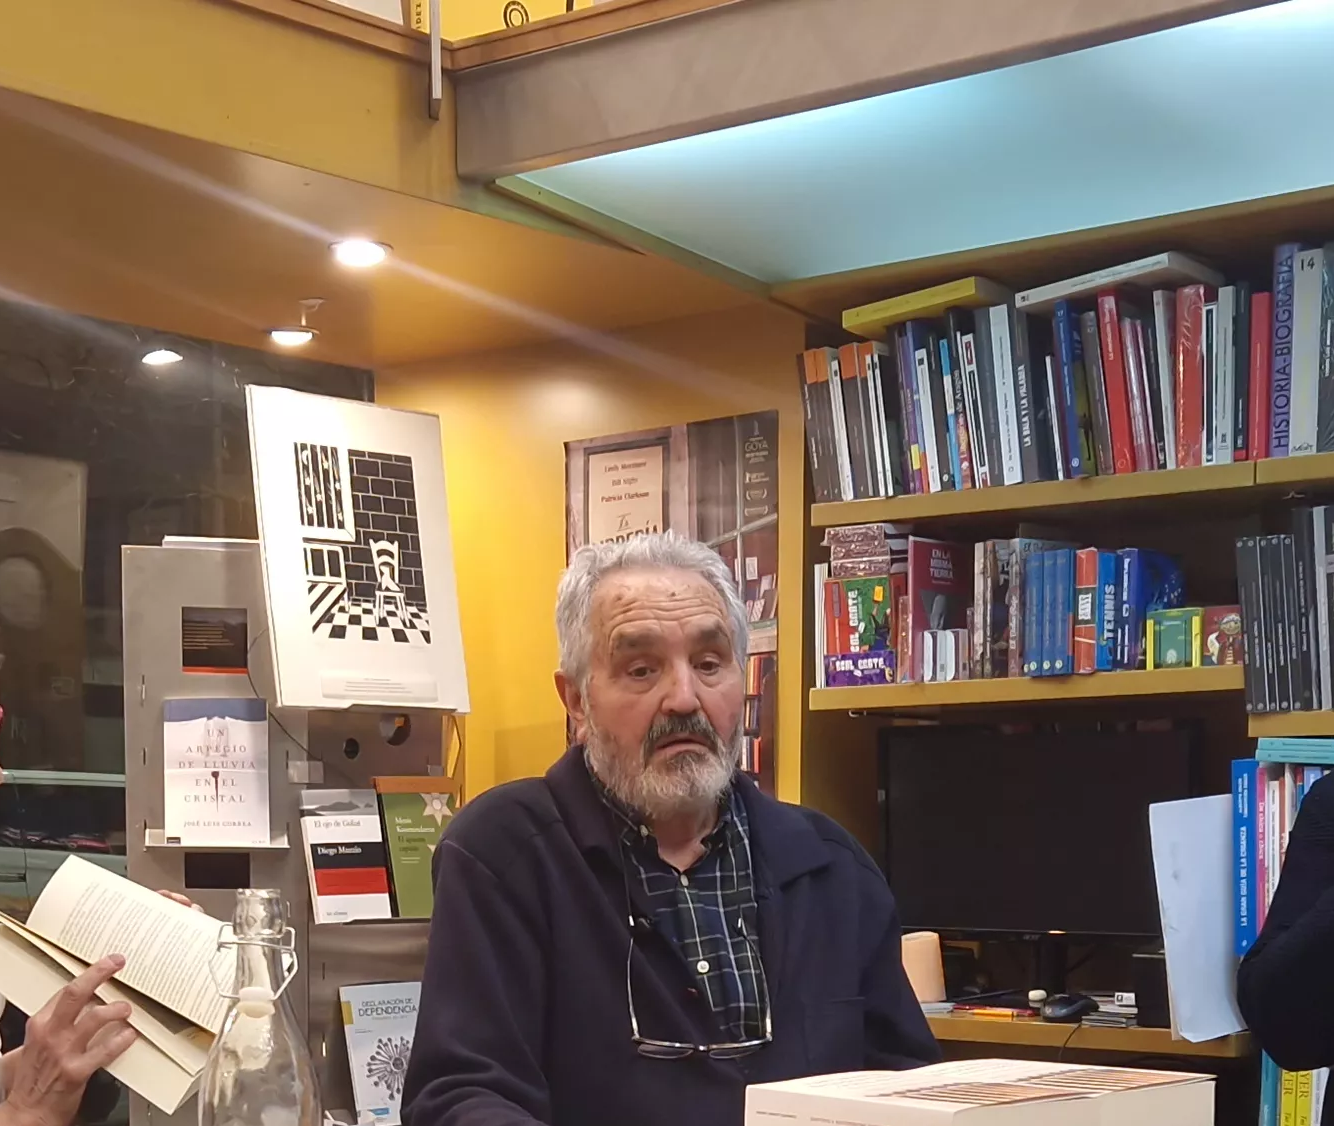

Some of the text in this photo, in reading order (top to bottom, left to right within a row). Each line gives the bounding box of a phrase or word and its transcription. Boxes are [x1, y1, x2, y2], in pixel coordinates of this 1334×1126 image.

[1299, 256, 1316, 271] 14
[1104, 584, 1115, 640] TENNIS
[207, 729, 225, 737] UN
[185, 745, 247, 754] ARPEGIO
[179, 761, 256, 770] DE LLUVIA
[196, 779, 238, 787] EN EL
[184, 795, 246, 804] CRISTAL
[1239, 879, 1247, 895] GUÍA
[358, 1005, 418, 1017] DEPENDENCIA
